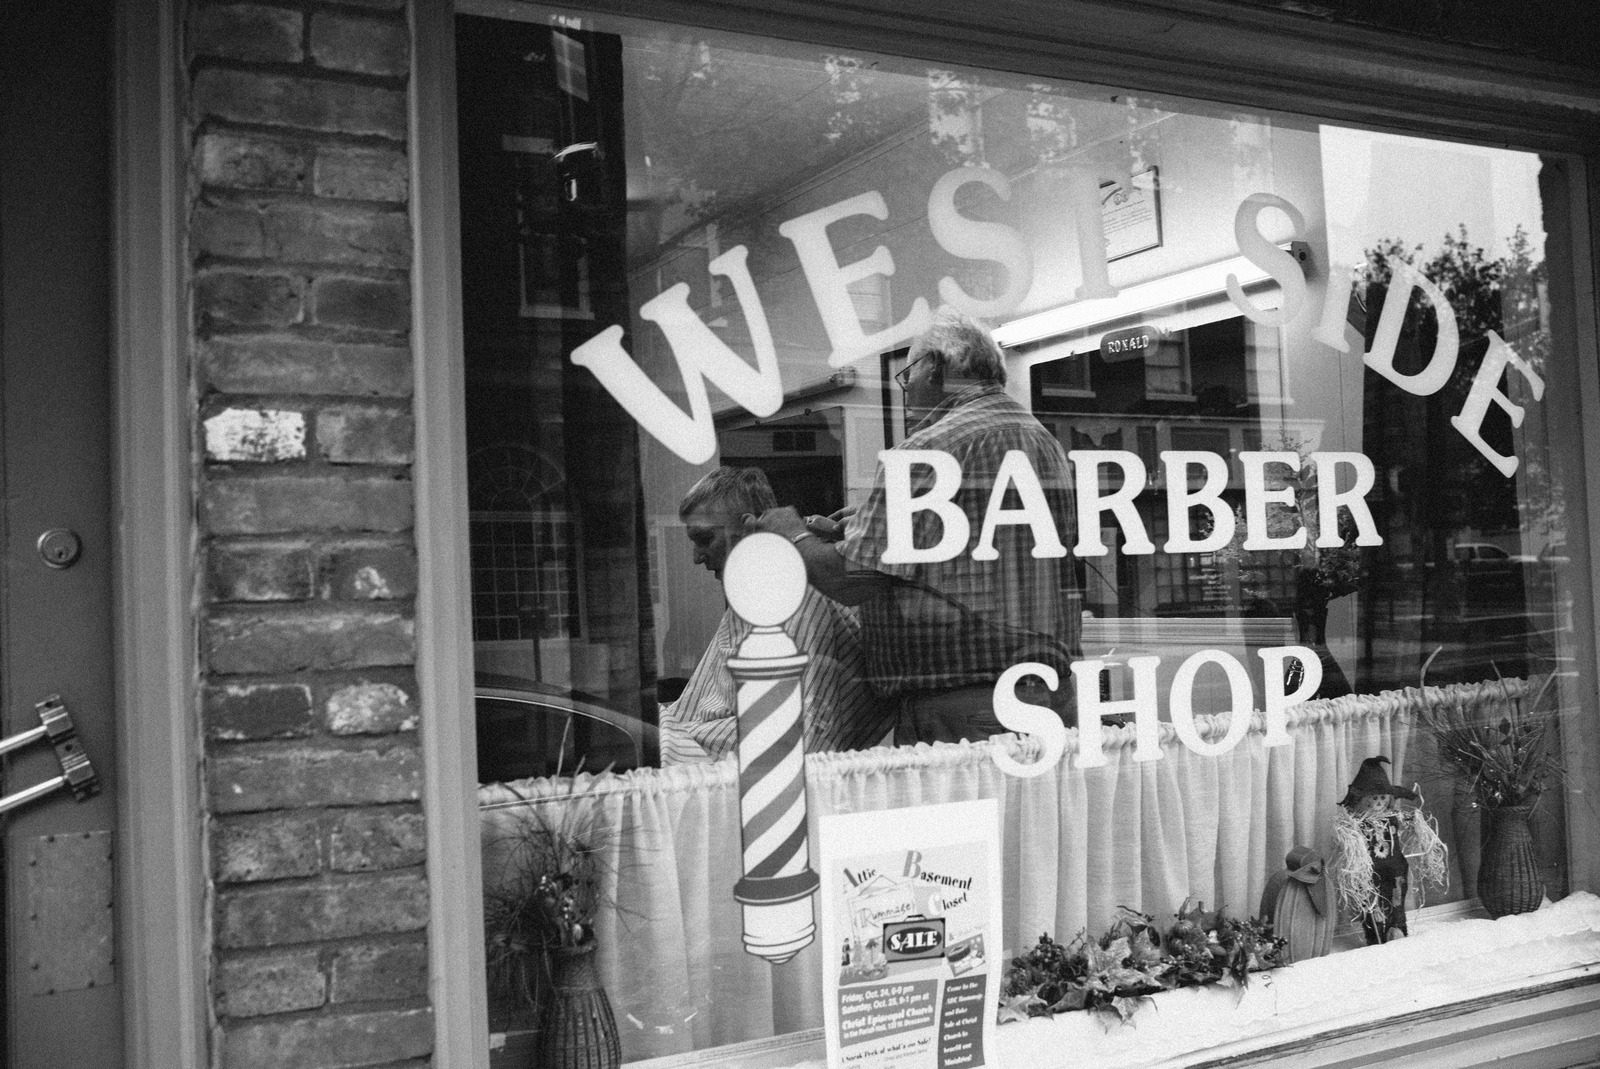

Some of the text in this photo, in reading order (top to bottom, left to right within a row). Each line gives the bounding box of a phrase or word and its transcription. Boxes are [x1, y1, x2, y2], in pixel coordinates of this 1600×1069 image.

[571, 163, 1546, 478] WEST SIDE
[1107, 334, 1150, 354] RONALD
[878, 449, 1384, 565] BARBER
[990, 645, 1323, 778] SHOP
[843, 867, 876, 894] Attic
[902, 850, 973, 890] Basement
[854, 903, 912, 929] Rummage
[927, 891, 968, 916] Closet
[889, 930, 938, 952] SALE
[841, 993, 864, 1003] Friday,
[865, 990, 879, 1000] Oct.
[903, 985, 914, 995] pm
[841, 1003, 872, 1015] Saturday,
[873, 999, 887, 1009] Oct.
[910, 993, 922, 1004] pm
[922, 992, 930, 1001] at
[841, 1016, 866, 1030] Christ
[867, 1008, 905, 1026] Episcopal
[906, 1004, 934, 1017] Church
[961, 1016, 978, 1025] Christ
